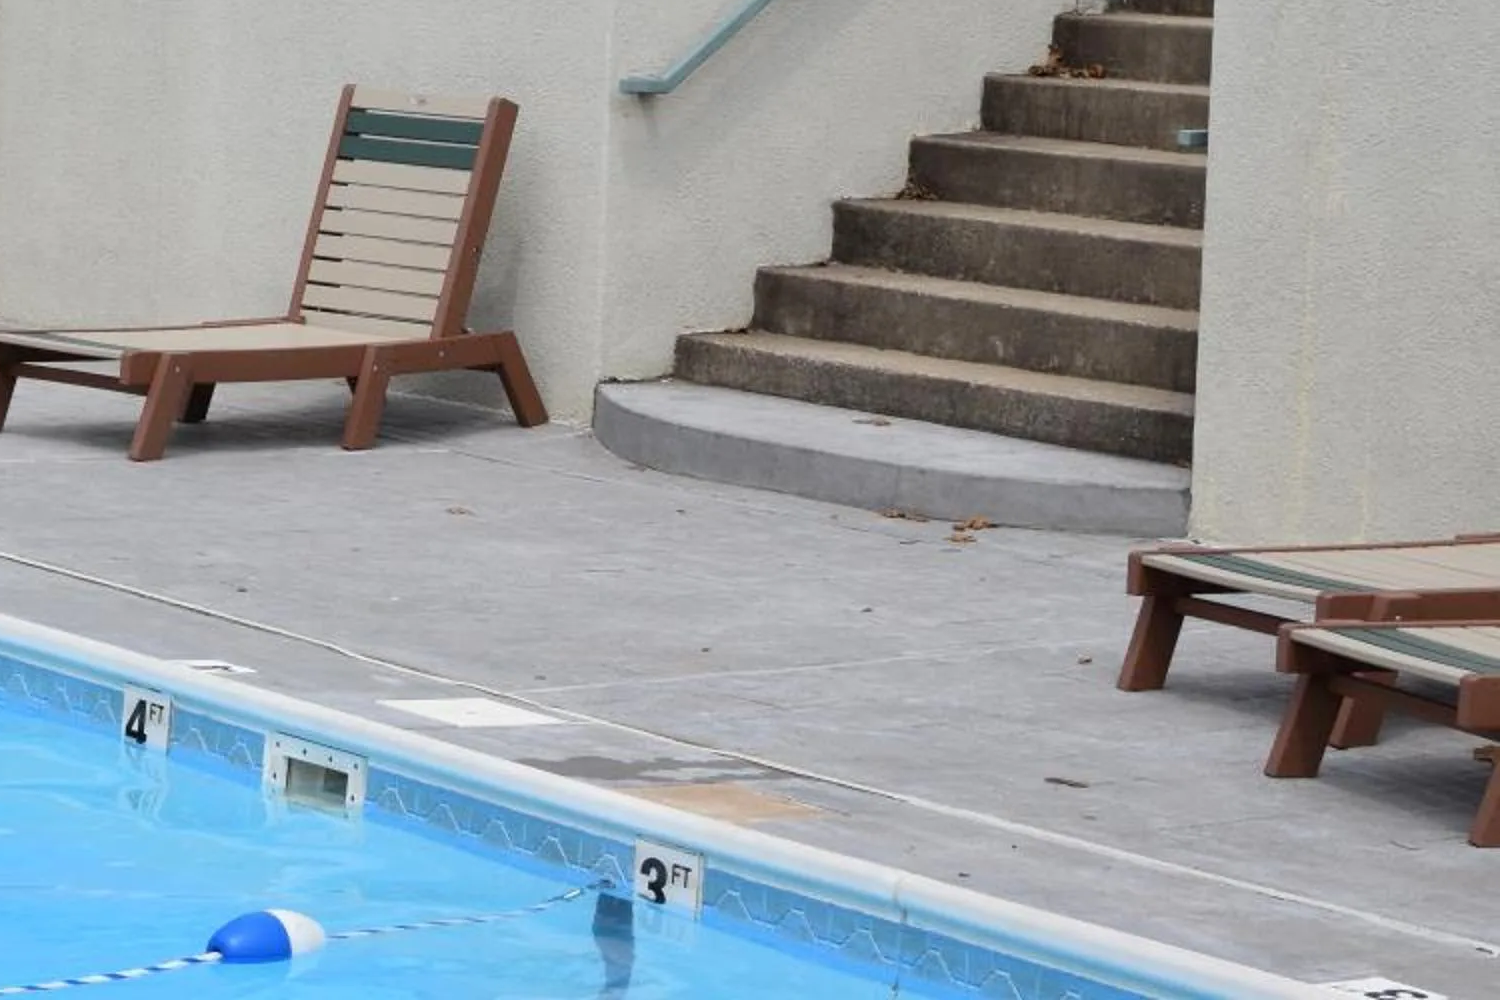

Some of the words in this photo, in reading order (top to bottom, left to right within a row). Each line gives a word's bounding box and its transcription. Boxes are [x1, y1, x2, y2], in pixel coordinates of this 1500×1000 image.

[125, 699, 147, 744] 4
[149, 703, 165, 724] FT
[640, 857, 667, 904] 3
[671, 863, 692, 888] FT
